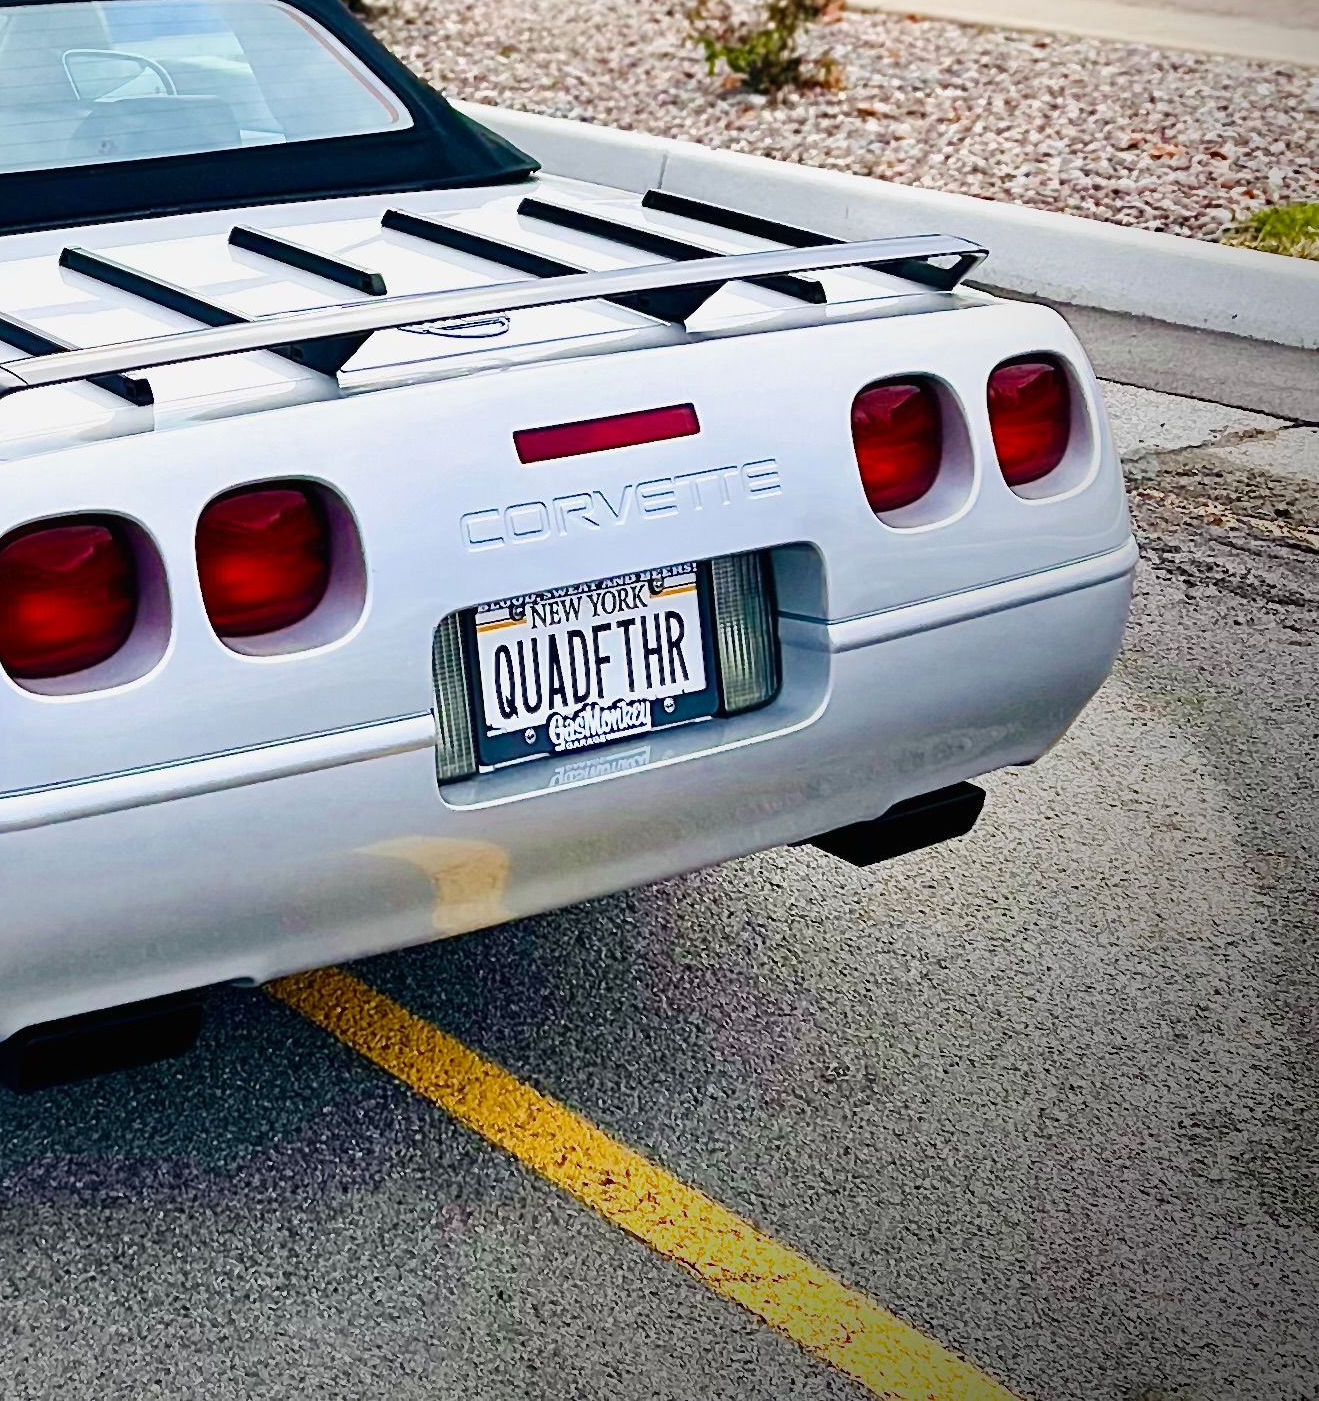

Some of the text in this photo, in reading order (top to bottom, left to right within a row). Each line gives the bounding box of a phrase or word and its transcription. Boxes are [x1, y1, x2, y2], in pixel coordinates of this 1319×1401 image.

[460, 458, 782, 553] CORVETTE
[530, 583, 648, 630] NEW YORK
[601, 574, 637, 589] AND
[494, 610, 690, 720] QUADFTHR
